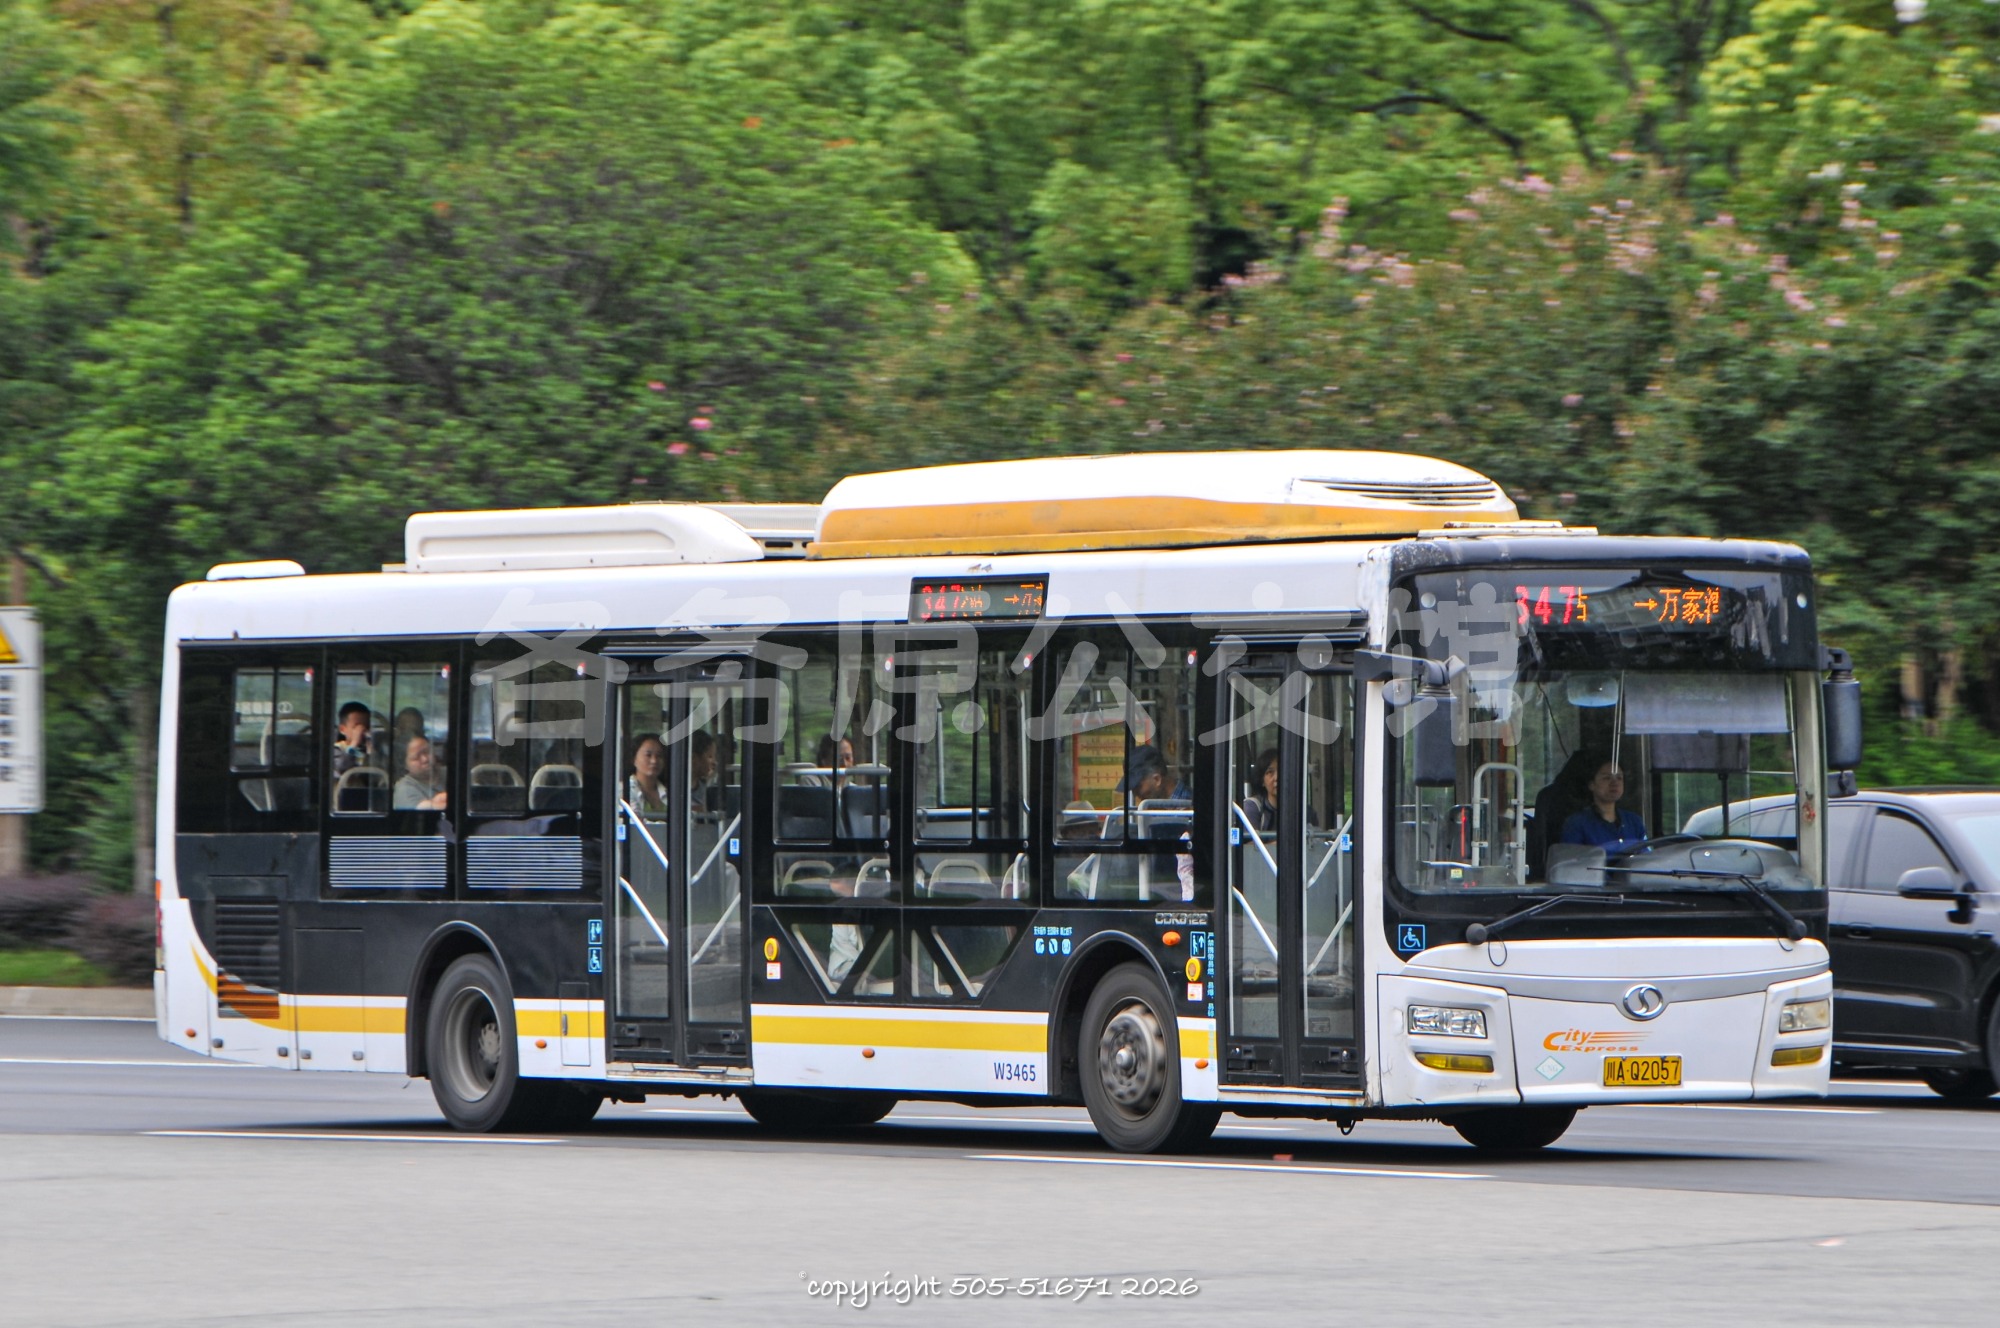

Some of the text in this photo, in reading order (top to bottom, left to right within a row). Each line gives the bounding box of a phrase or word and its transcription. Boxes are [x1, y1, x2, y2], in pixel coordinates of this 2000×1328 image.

[1543, 1028, 1592, 1051] City
[1558, 1045, 1639, 1053] Express
[993, 1062, 1036, 1081] W3465
